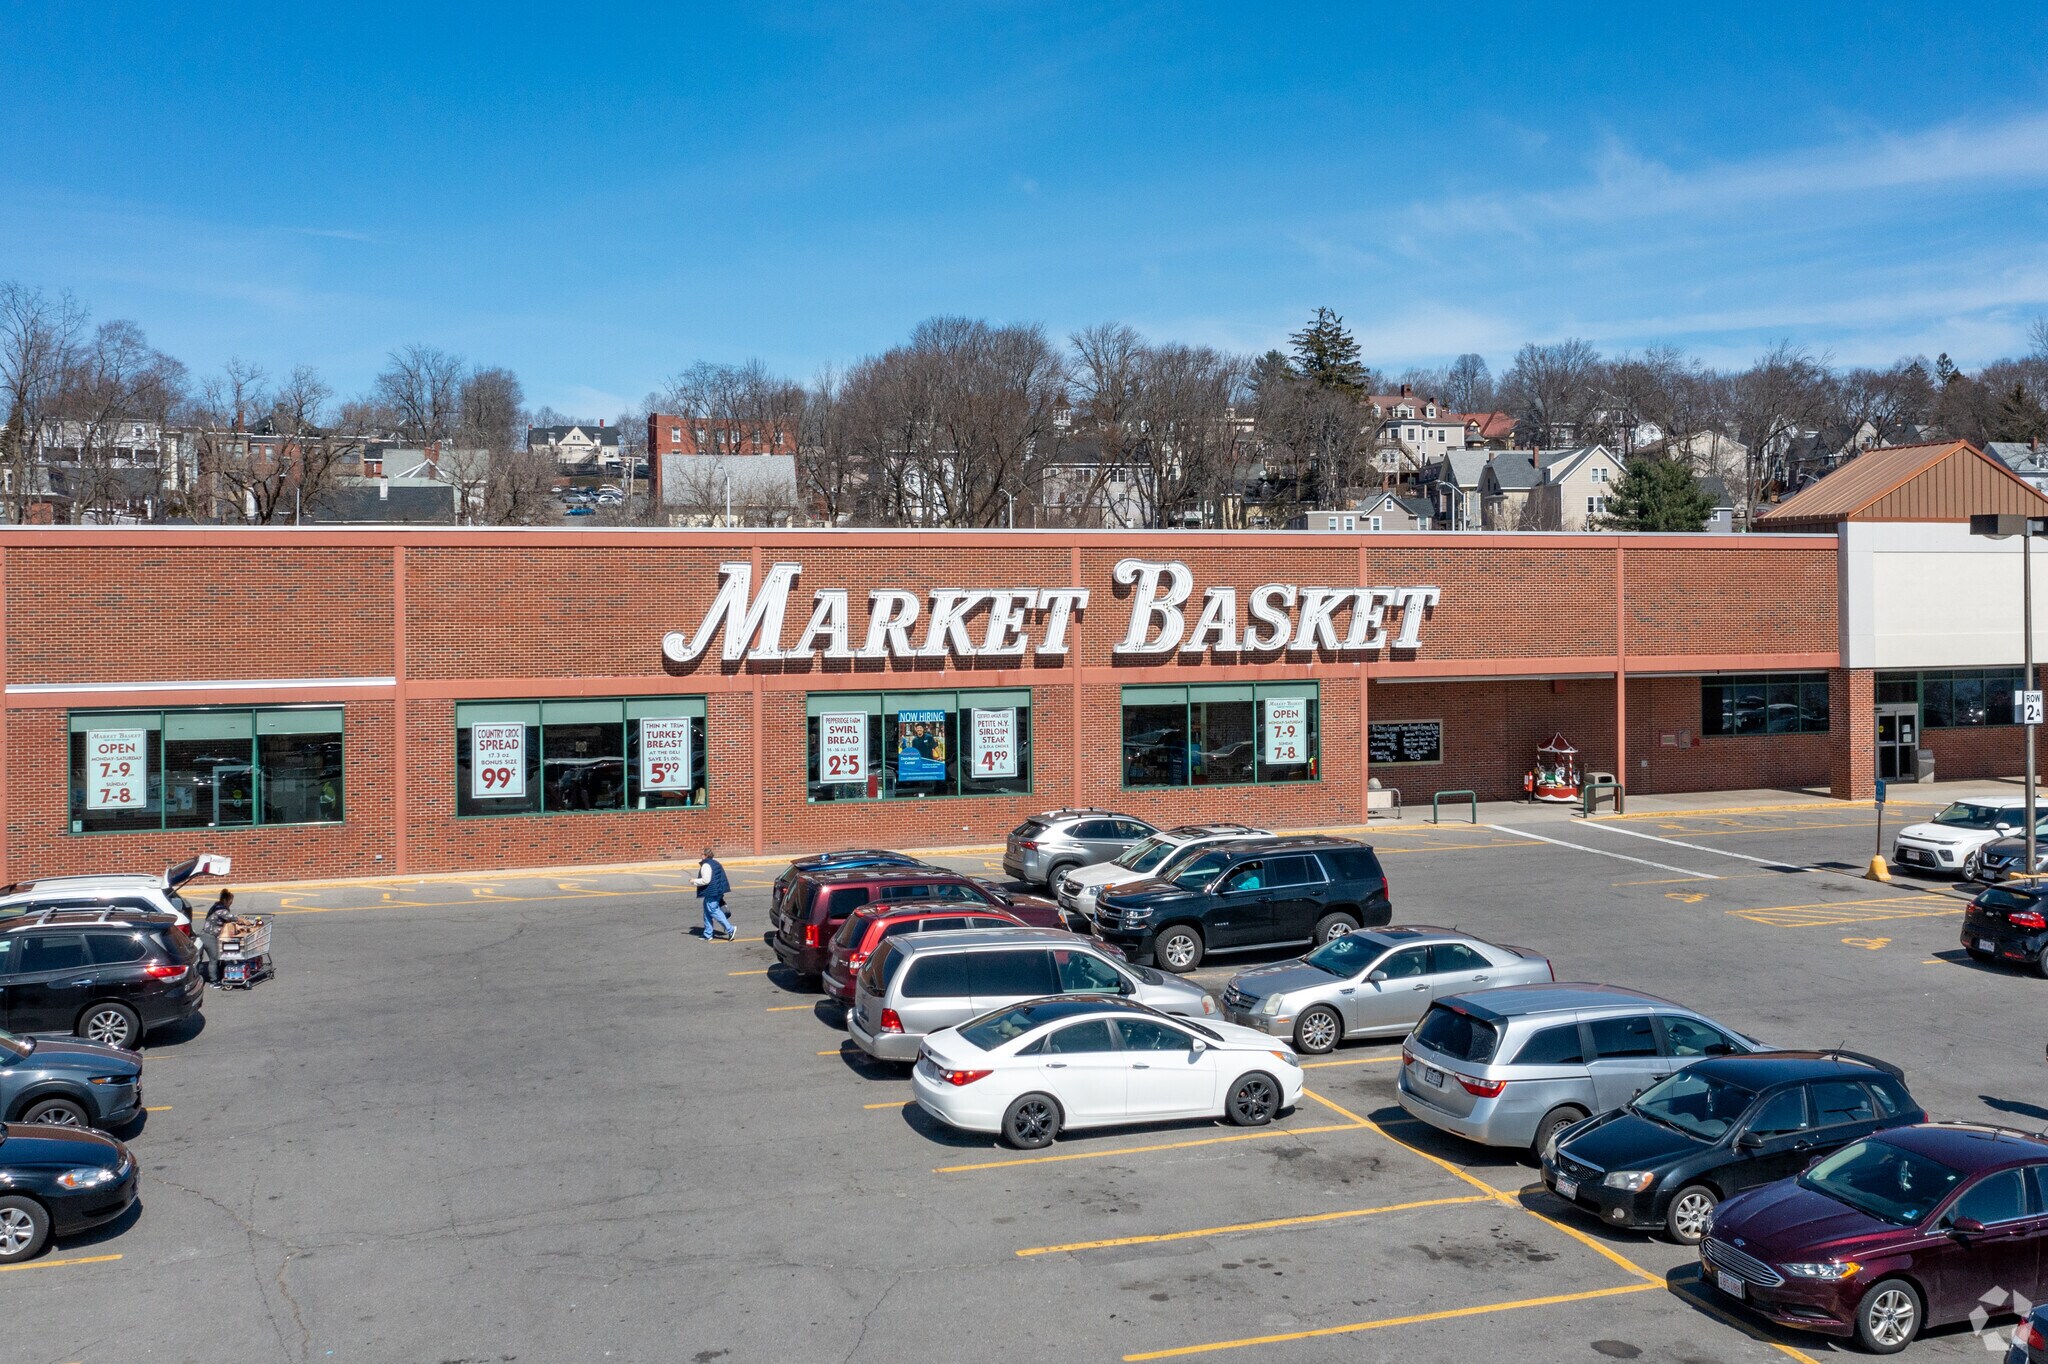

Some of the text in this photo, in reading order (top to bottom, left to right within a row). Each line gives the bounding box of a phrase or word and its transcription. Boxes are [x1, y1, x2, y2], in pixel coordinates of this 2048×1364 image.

[662, 558, 1441, 662] MARKET BASKET
[2026, 694, 2041, 703] ROW
[900, 711, 944, 722] NOW HIRING
[1273, 710, 1299, 718] OPEN
[478, 728, 520, 739] COUNTRY CROC
[646, 730, 684, 738] TURKEY
[829, 726, 858, 734] SWIRL
[480, 739, 519, 750] SPREAD
[646, 740, 682, 748] BREAST
[828, 736, 860, 744] BREAD
[98, 743, 136, 754] OPEN
